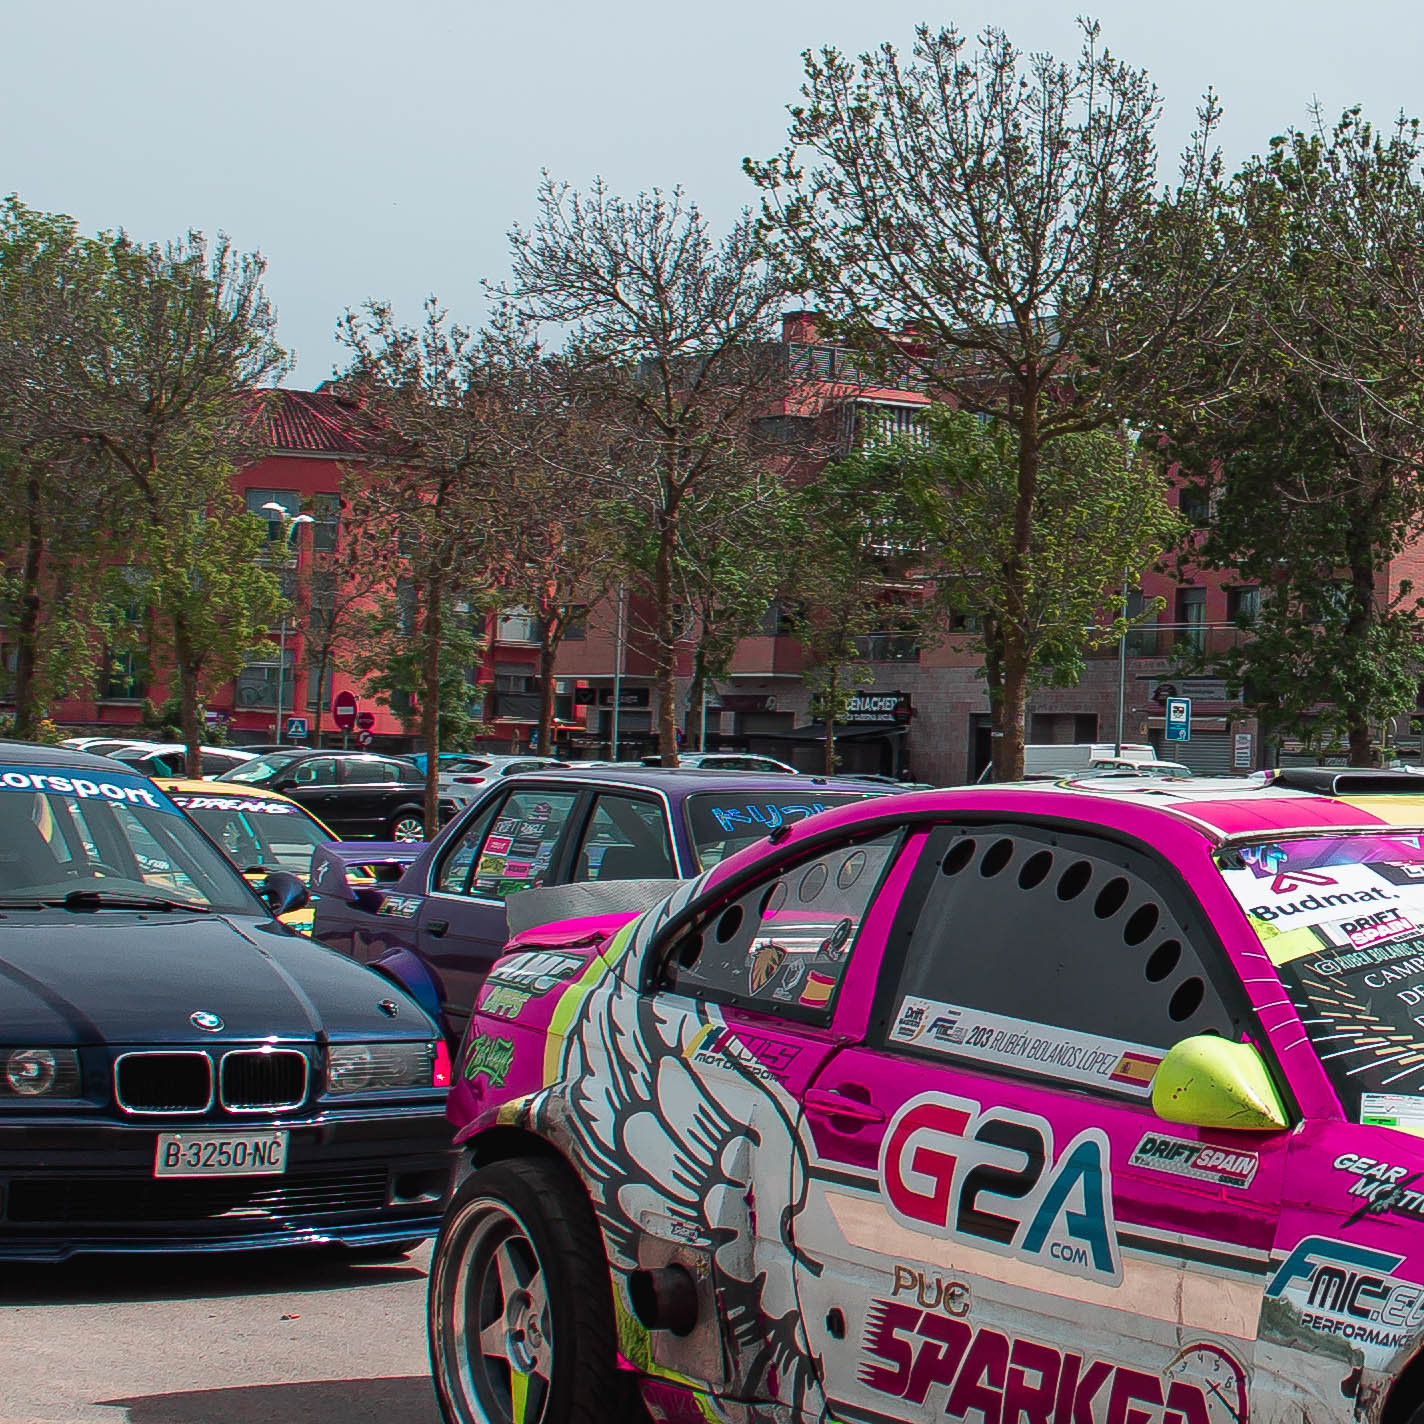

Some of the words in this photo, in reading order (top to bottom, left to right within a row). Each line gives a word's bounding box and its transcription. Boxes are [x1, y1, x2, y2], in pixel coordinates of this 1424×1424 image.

[0, 772, 161, 808] orsport
[1340, 907, 1401, 935] DRIFT
[1350, 917, 1414, 946] SPAIN
[965, 1024, 994, 1049] 203
[989, 1028, 1031, 1058] RUBÉN
[1026, 1039, 1084, 1069] BOLAÑOS
[1075, 1044, 1120, 1077] LÓPEZ
[1137, 1136, 1202, 1164] DRIFT
[1196, 1149, 1257, 1175] SPAIN
[1333, 1153, 1409, 1184] GEAR
[884, 1103, 1114, 1274] G2A
[1301, 1312, 1414, 1348] PERFORMANCE
